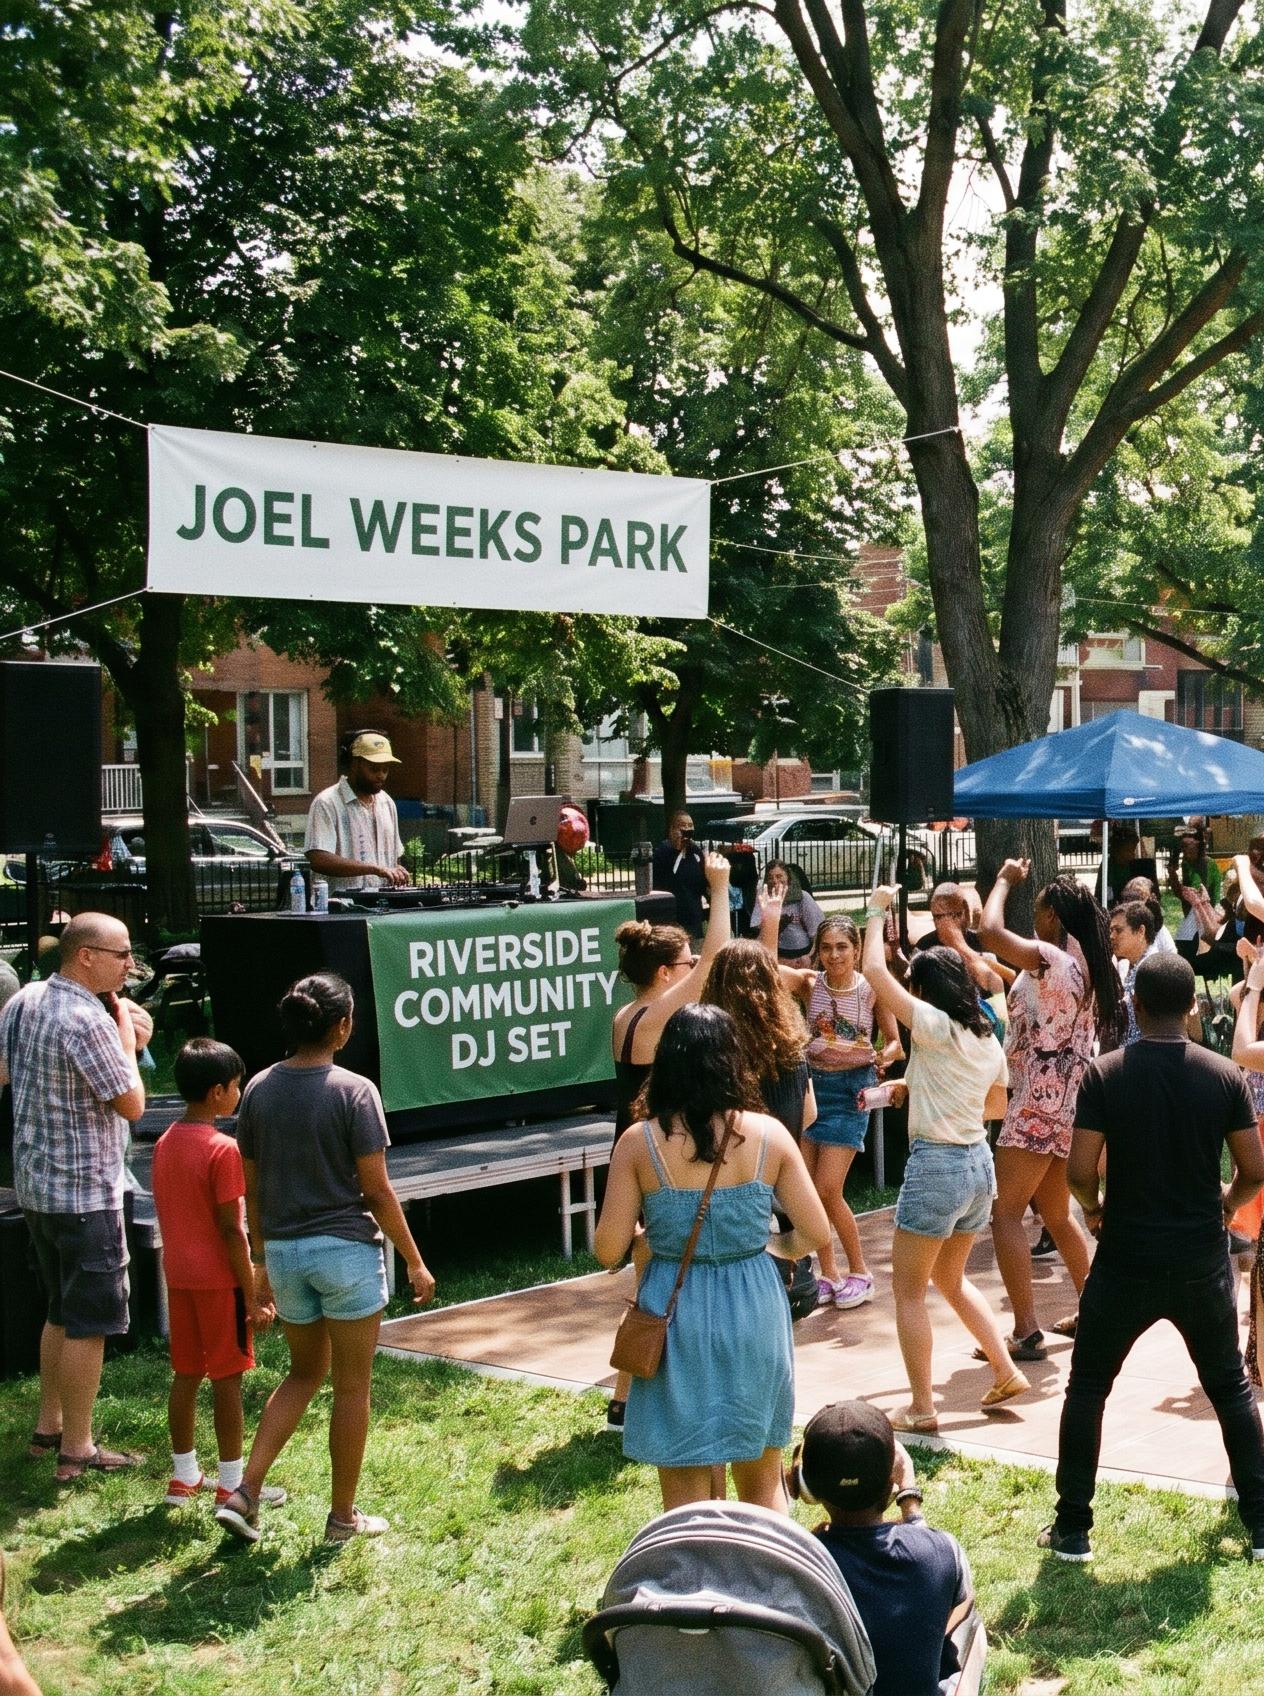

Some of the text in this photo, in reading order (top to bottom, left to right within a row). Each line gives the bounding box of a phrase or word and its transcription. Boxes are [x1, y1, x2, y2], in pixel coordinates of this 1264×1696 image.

[176, 484, 688, 574] JOEL WEEKS PARK
[409, 927, 602, 979] RIVERSIDE
[394, 970, 619, 1028] COMMUNITY
[451, 1021, 572, 1070] DJ SET
